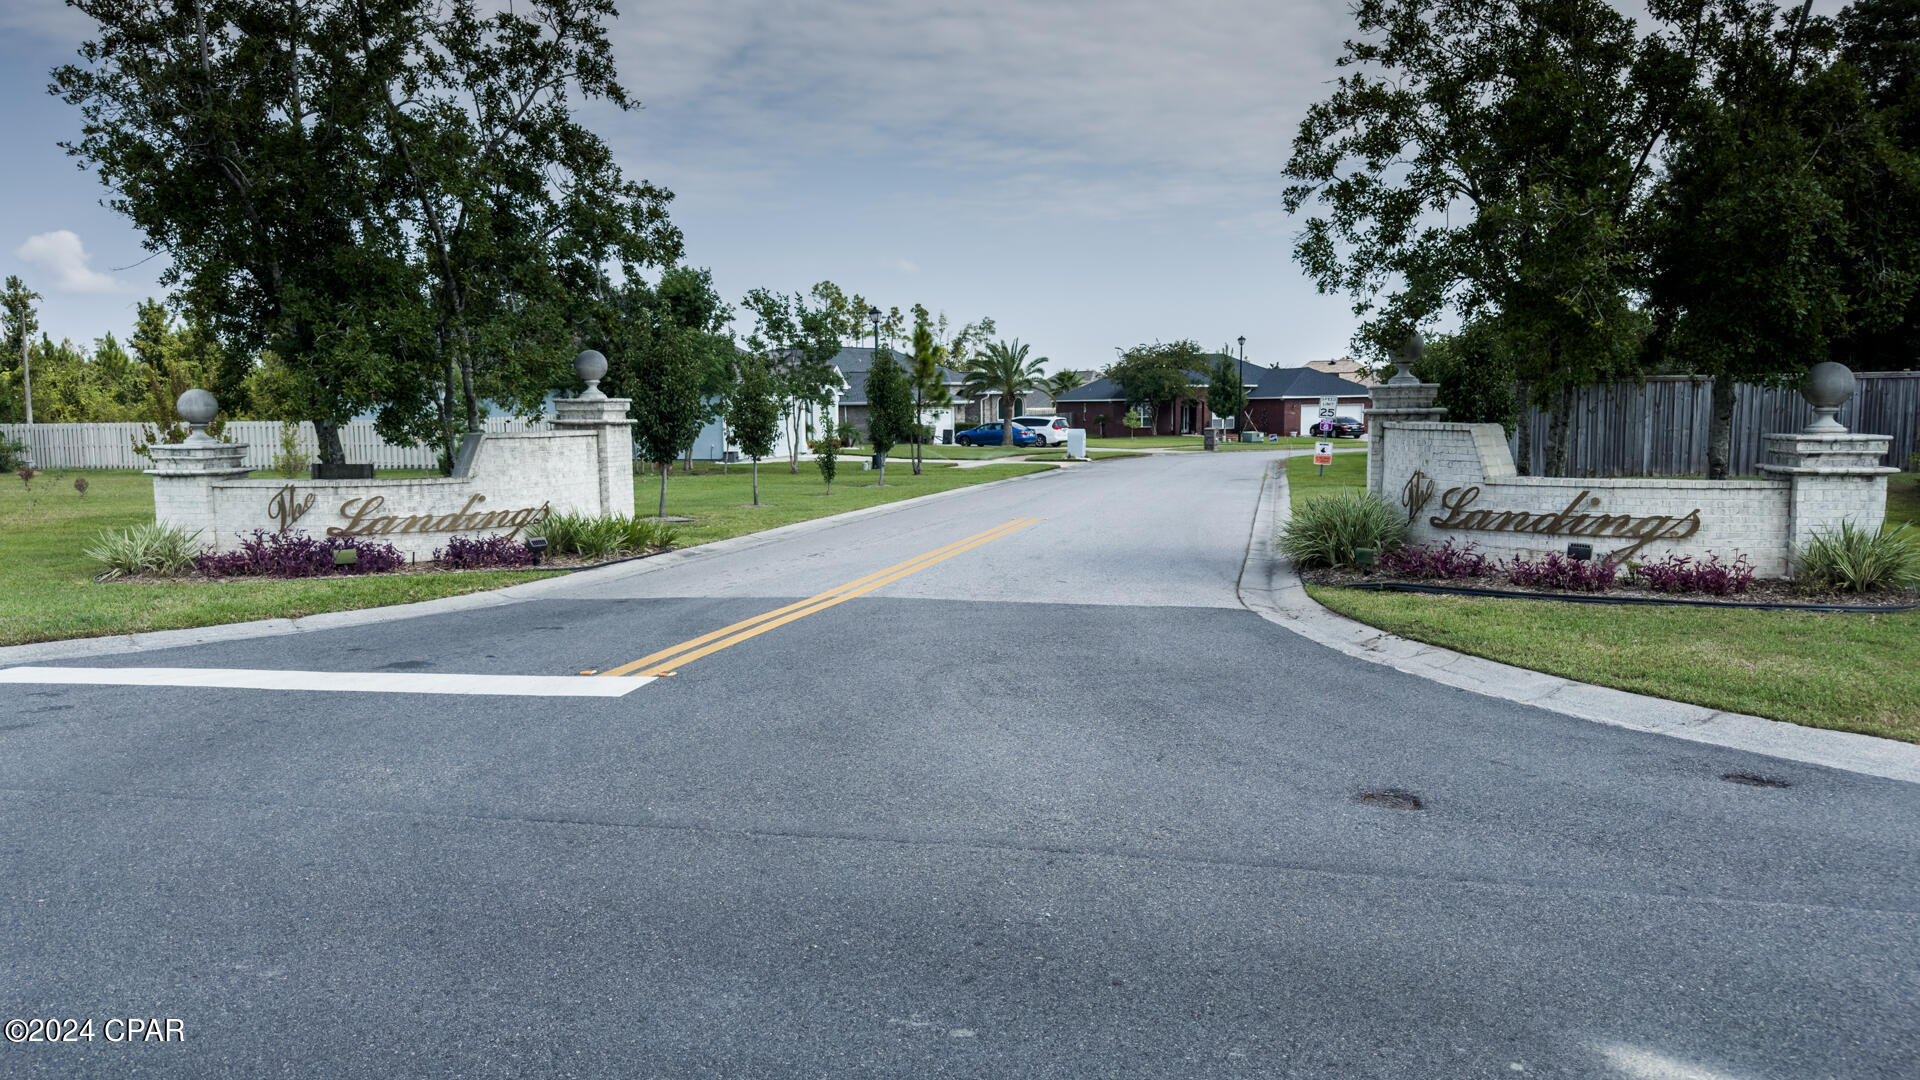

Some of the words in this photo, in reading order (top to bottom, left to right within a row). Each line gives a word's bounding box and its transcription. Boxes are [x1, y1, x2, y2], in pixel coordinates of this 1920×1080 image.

[1320, 408, 1335, 417] 25
[268, 484, 315, 534] The
[327, 493, 550, 546] Landings
[1402, 468, 1435, 527] The
[1429, 486, 1700, 565] Landings
